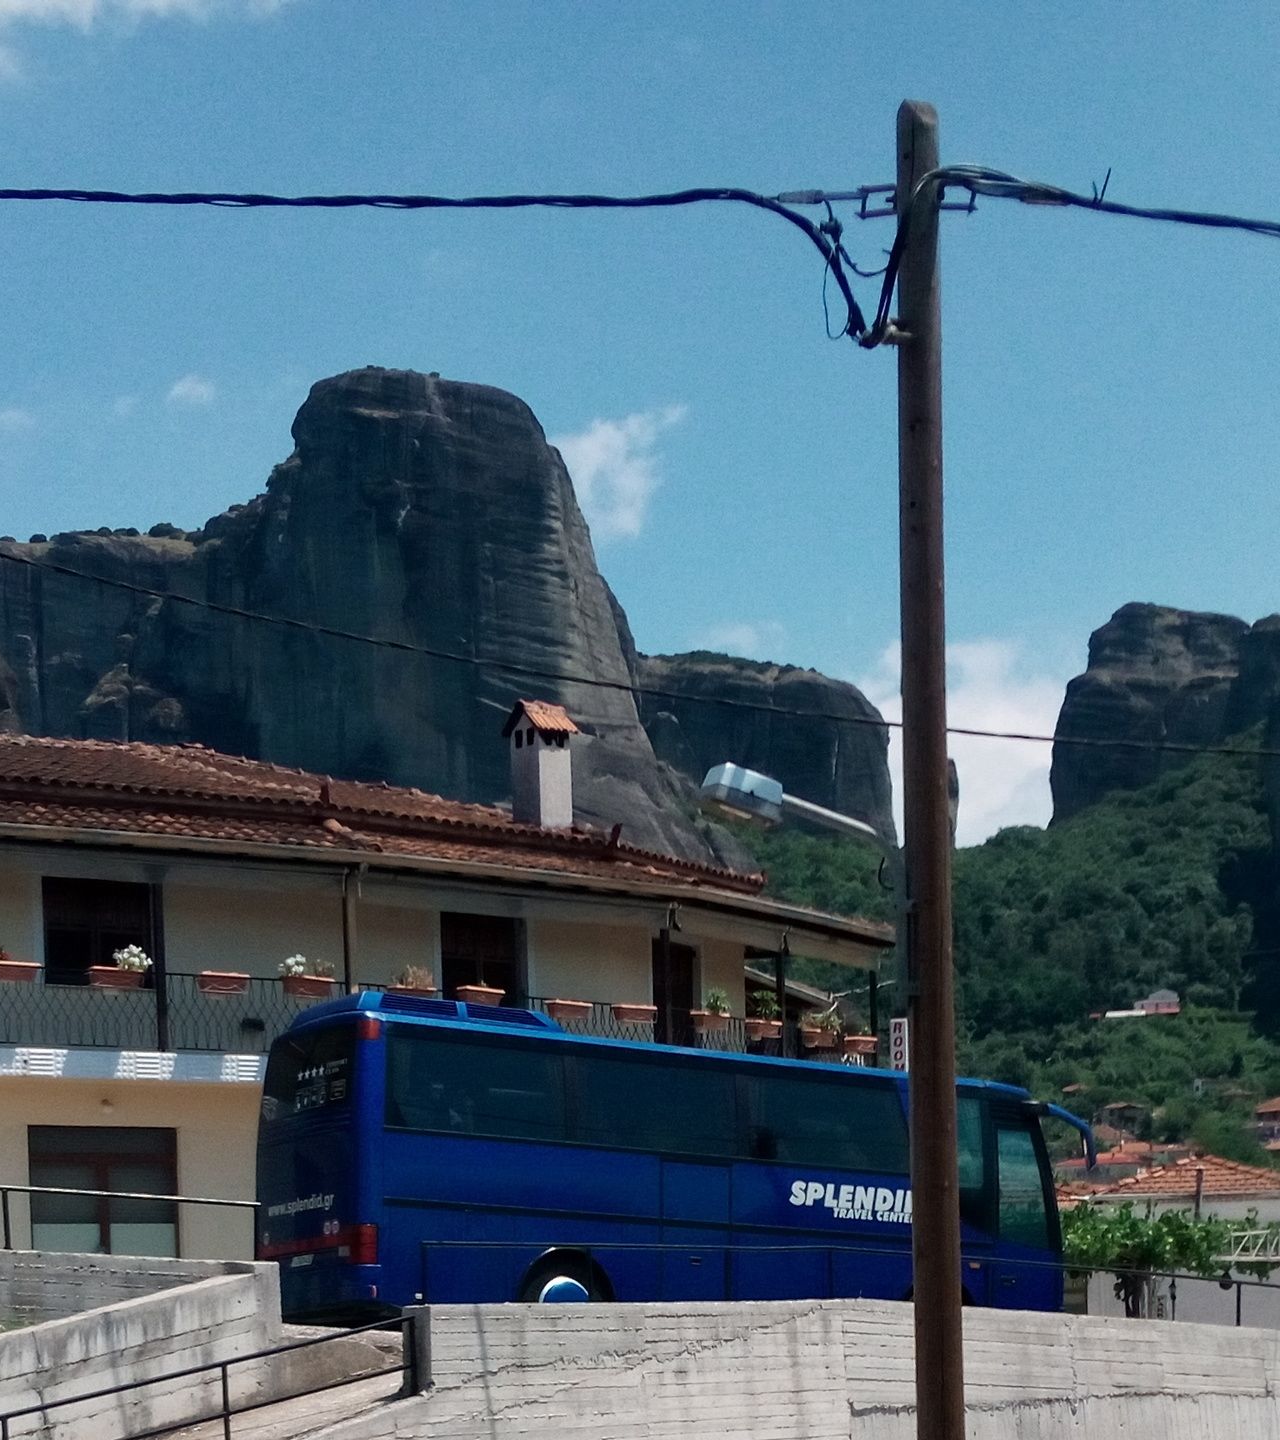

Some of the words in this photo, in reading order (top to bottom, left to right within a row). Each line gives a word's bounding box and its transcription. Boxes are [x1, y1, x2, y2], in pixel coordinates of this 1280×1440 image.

[268, 1192, 335, 1217] www.splendid.gr
[833, 1207, 873, 1221] TRAVEL
[876, 1211, 912, 1224] CENTE
